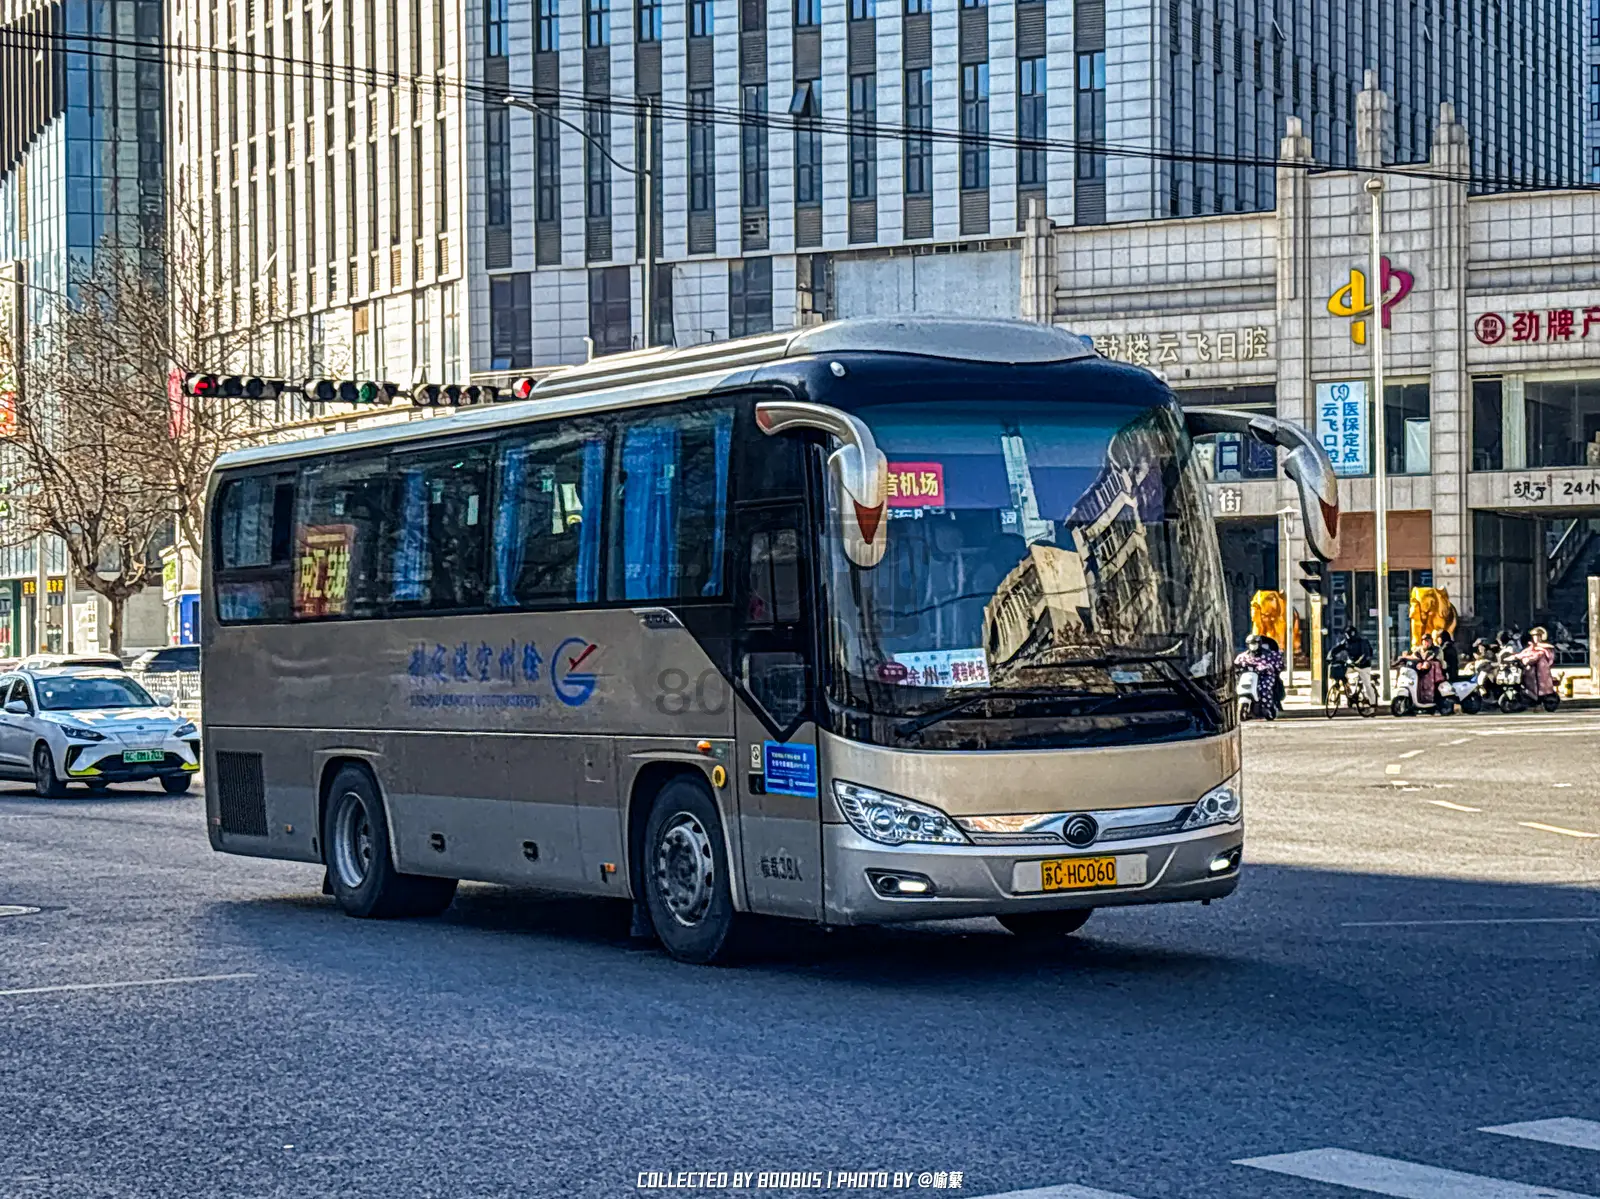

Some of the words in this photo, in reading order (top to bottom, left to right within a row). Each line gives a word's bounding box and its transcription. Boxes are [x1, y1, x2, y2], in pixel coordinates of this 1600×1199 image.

[1096, 326, 1268, 366] 鼓楼云飞口腔
[1342, 401, 1360, 463] 医保定点
